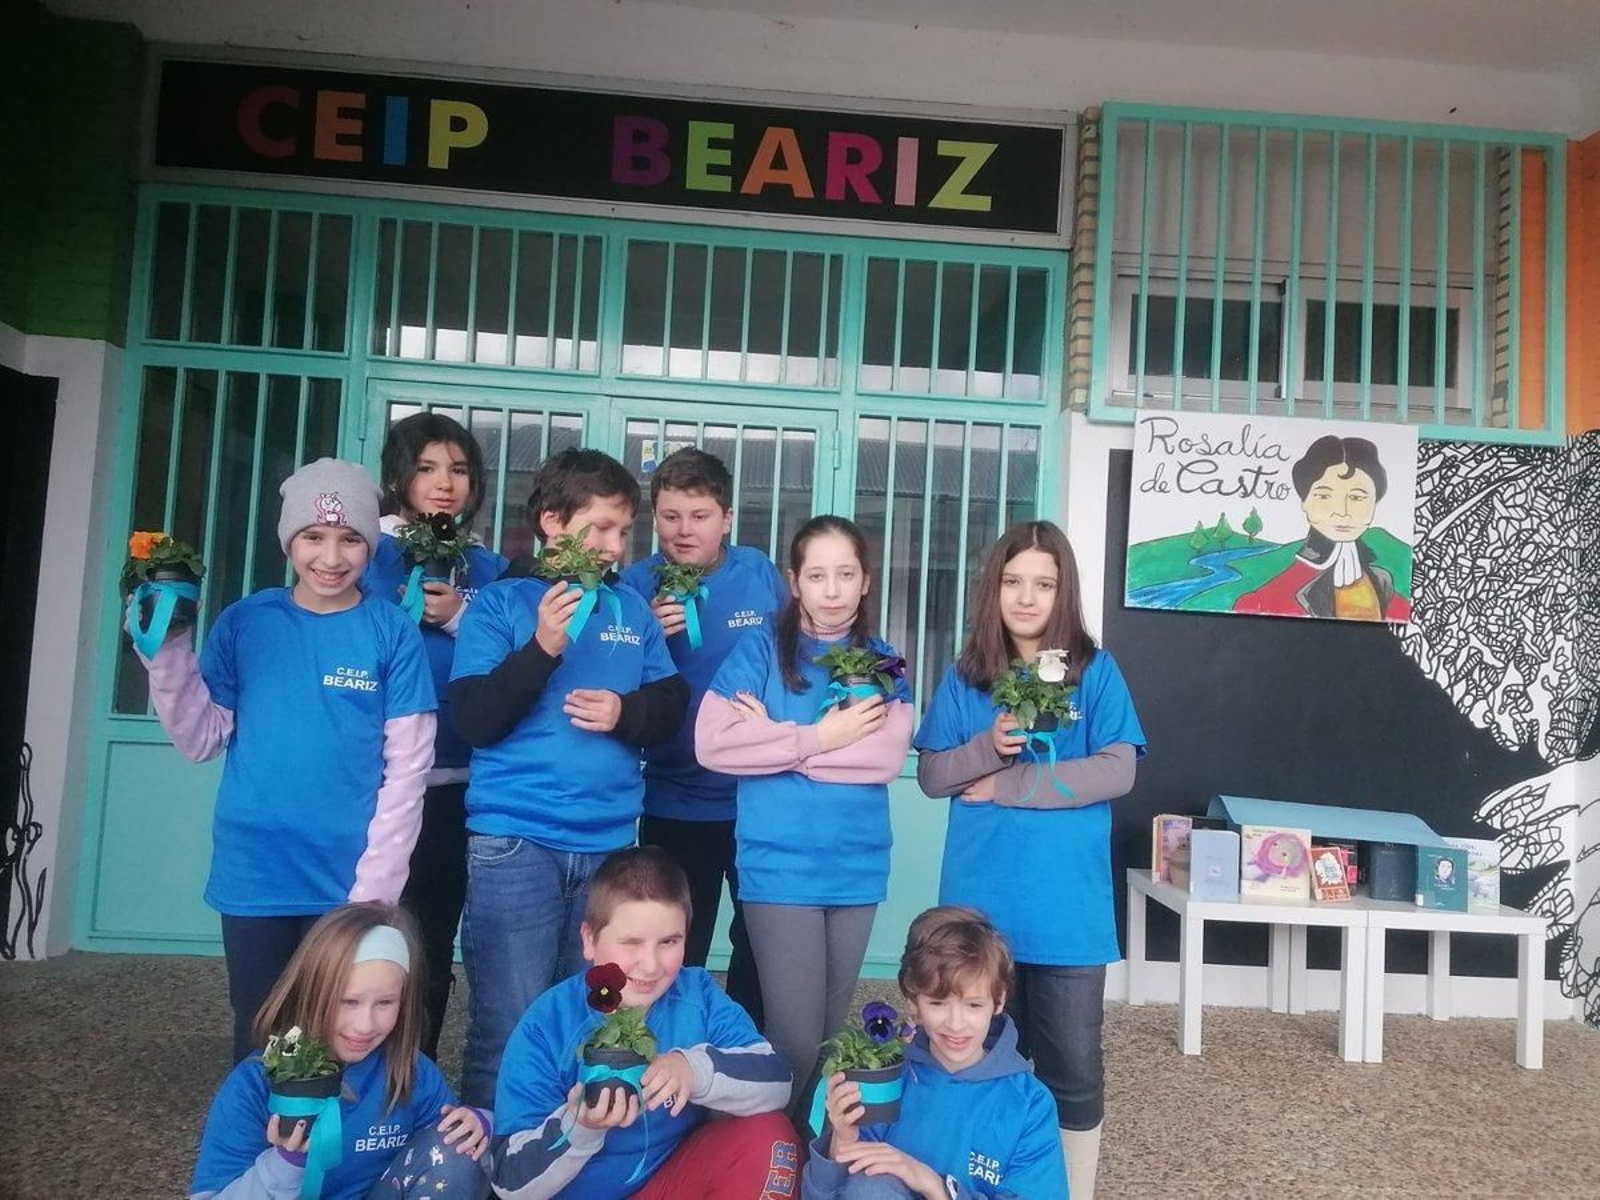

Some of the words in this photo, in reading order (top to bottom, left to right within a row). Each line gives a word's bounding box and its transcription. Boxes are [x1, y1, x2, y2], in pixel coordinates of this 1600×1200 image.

[238, 86, 489, 169] CEIP
[610, 114, 999, 212] BEARIZ
[1140, 416, 1290, 461] Rosalía
[1140, 463, 1171, 494] de
[1177, 459, 1292, 501] Castro
[600, 632, 641, 646] BEARIZ
[336, 667, 369, 679] C.E.I.P.
[323, 675, 378, 691] BEARIZ
[368, 1125, 401, 1136] C.E.I.P.
[354, 1134, 409, 1152] BEARIZ
